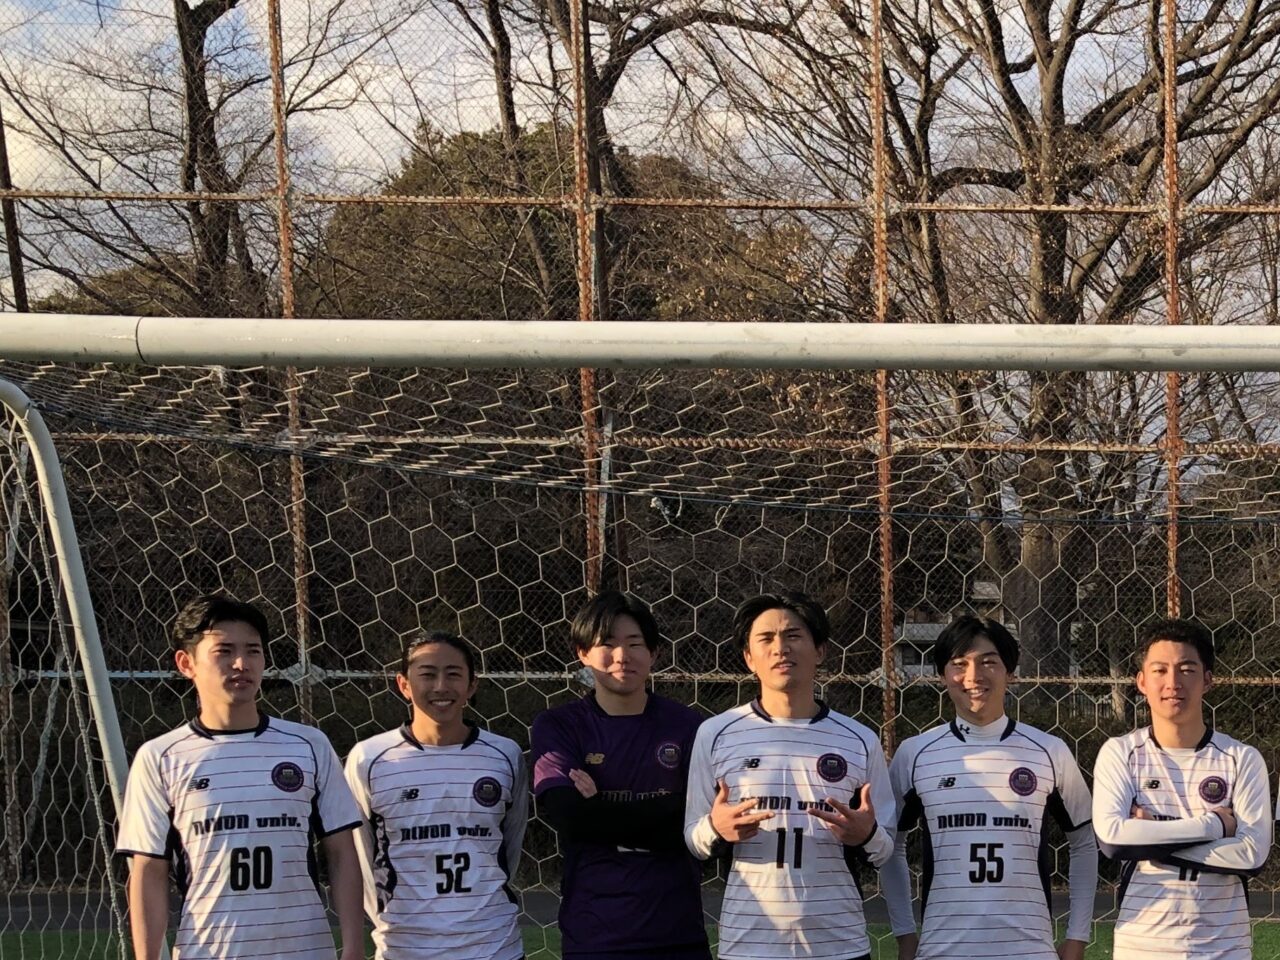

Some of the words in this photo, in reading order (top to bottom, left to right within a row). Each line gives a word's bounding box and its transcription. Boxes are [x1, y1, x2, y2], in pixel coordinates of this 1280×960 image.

[992, 814, 1032, 829] univ.
[230, 846, 273, 891] 60
[776, 827, 803, 869] 11
[969, 843, 1004, 883] 55
[435, 852, 472, 894] 52
